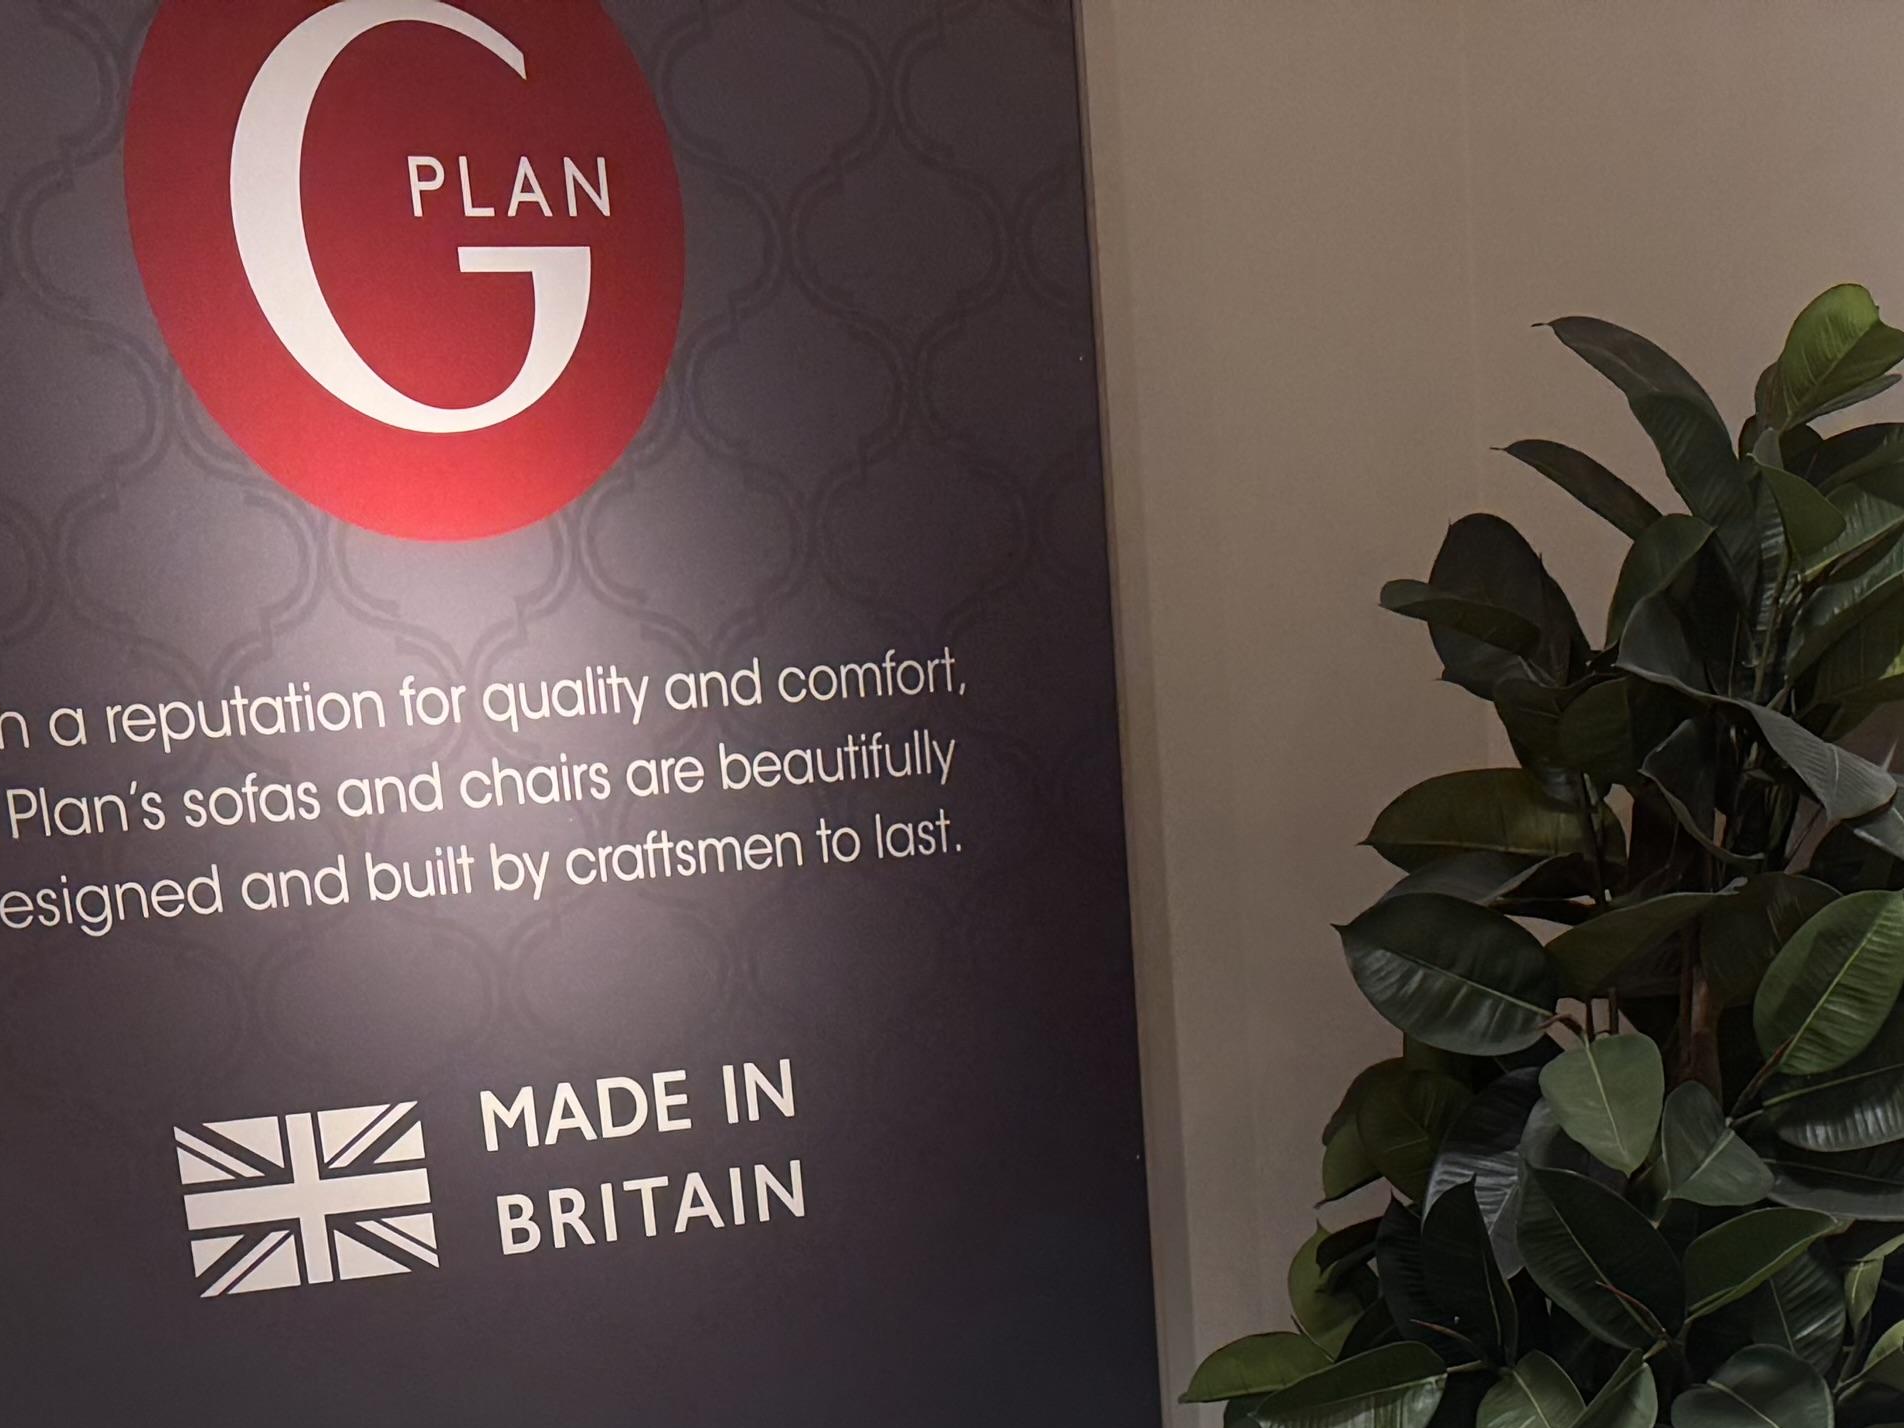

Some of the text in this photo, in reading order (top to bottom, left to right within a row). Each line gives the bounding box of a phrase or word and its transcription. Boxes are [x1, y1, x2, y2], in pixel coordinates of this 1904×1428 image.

[230, 0, 611, 433] G PLAN
[49, 707, 87, 747] a
[106, 676, 385, 754] reputation
[400, 675, 467, 726] for
[483, 665, 649, 734] quality
[665, 656, 763, 712] and
[778, 647, 968, 704] comfort,
[184, 761, 320, 828] sofas
[338, 760, 444, 818] and
[460, 752, 610, 809] chairs
[627, 756, 705, 797] are
[719, 731, 956, 790] beautifully
[242, 853, 349, 911] and
[365, 844, 475, 903] built
[490, 842, 550, 902] by
[566, 828, 804, 887] craftsmen
[816, 818, 861, 864] to
[875, 807, 964, 859] last.
[480, 1059, 795, 1152] MADE IN
[497, 1160, 805, 1255] BRITAIN
